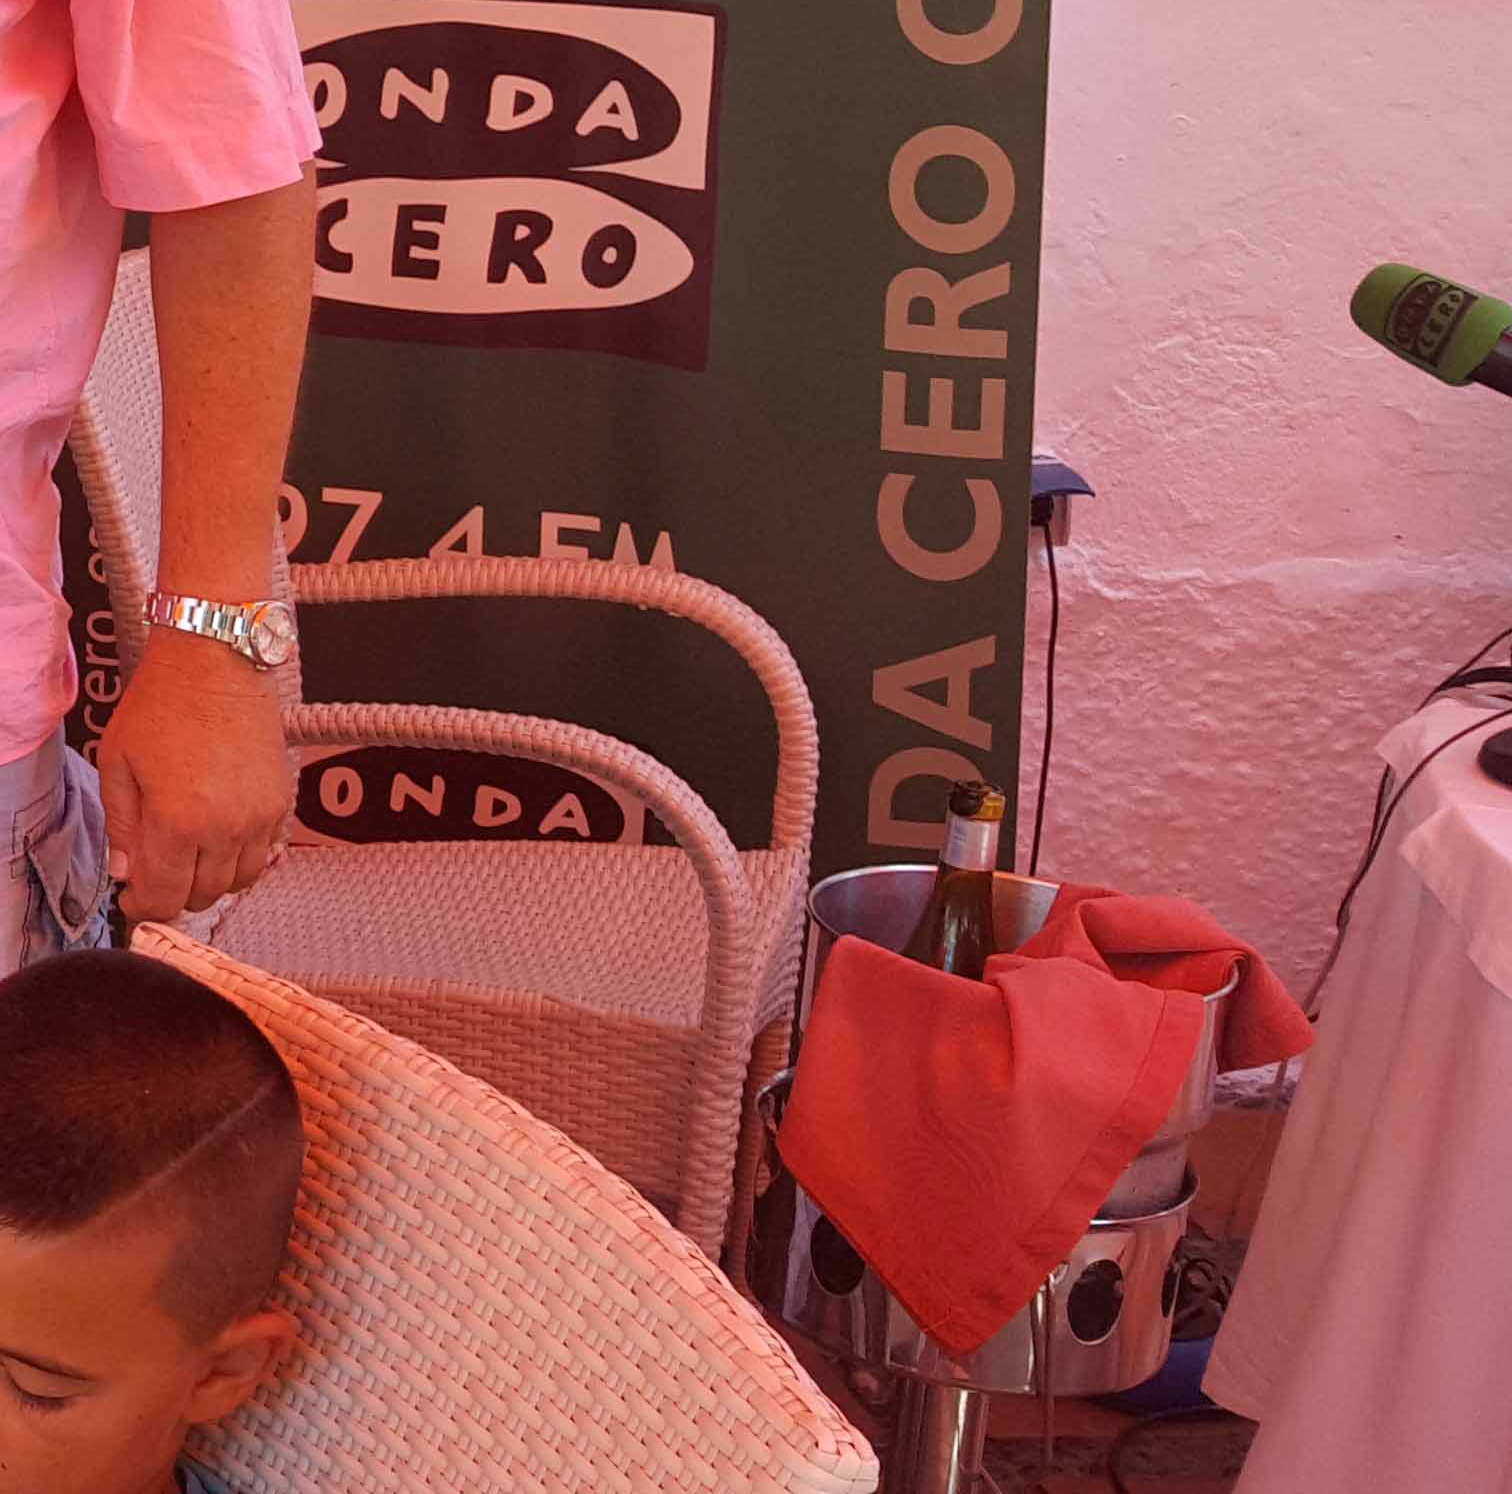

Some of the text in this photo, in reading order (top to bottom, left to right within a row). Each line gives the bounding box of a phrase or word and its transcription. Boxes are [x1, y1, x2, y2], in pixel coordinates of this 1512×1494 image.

[303, 62, 640, 141] ONDA
[314, 198, 637, 288] CERO
[875, 123, 1017, 583] CERO
[867, 633, 997, 850] DA
[319, 766, 591, 837] ONDA
